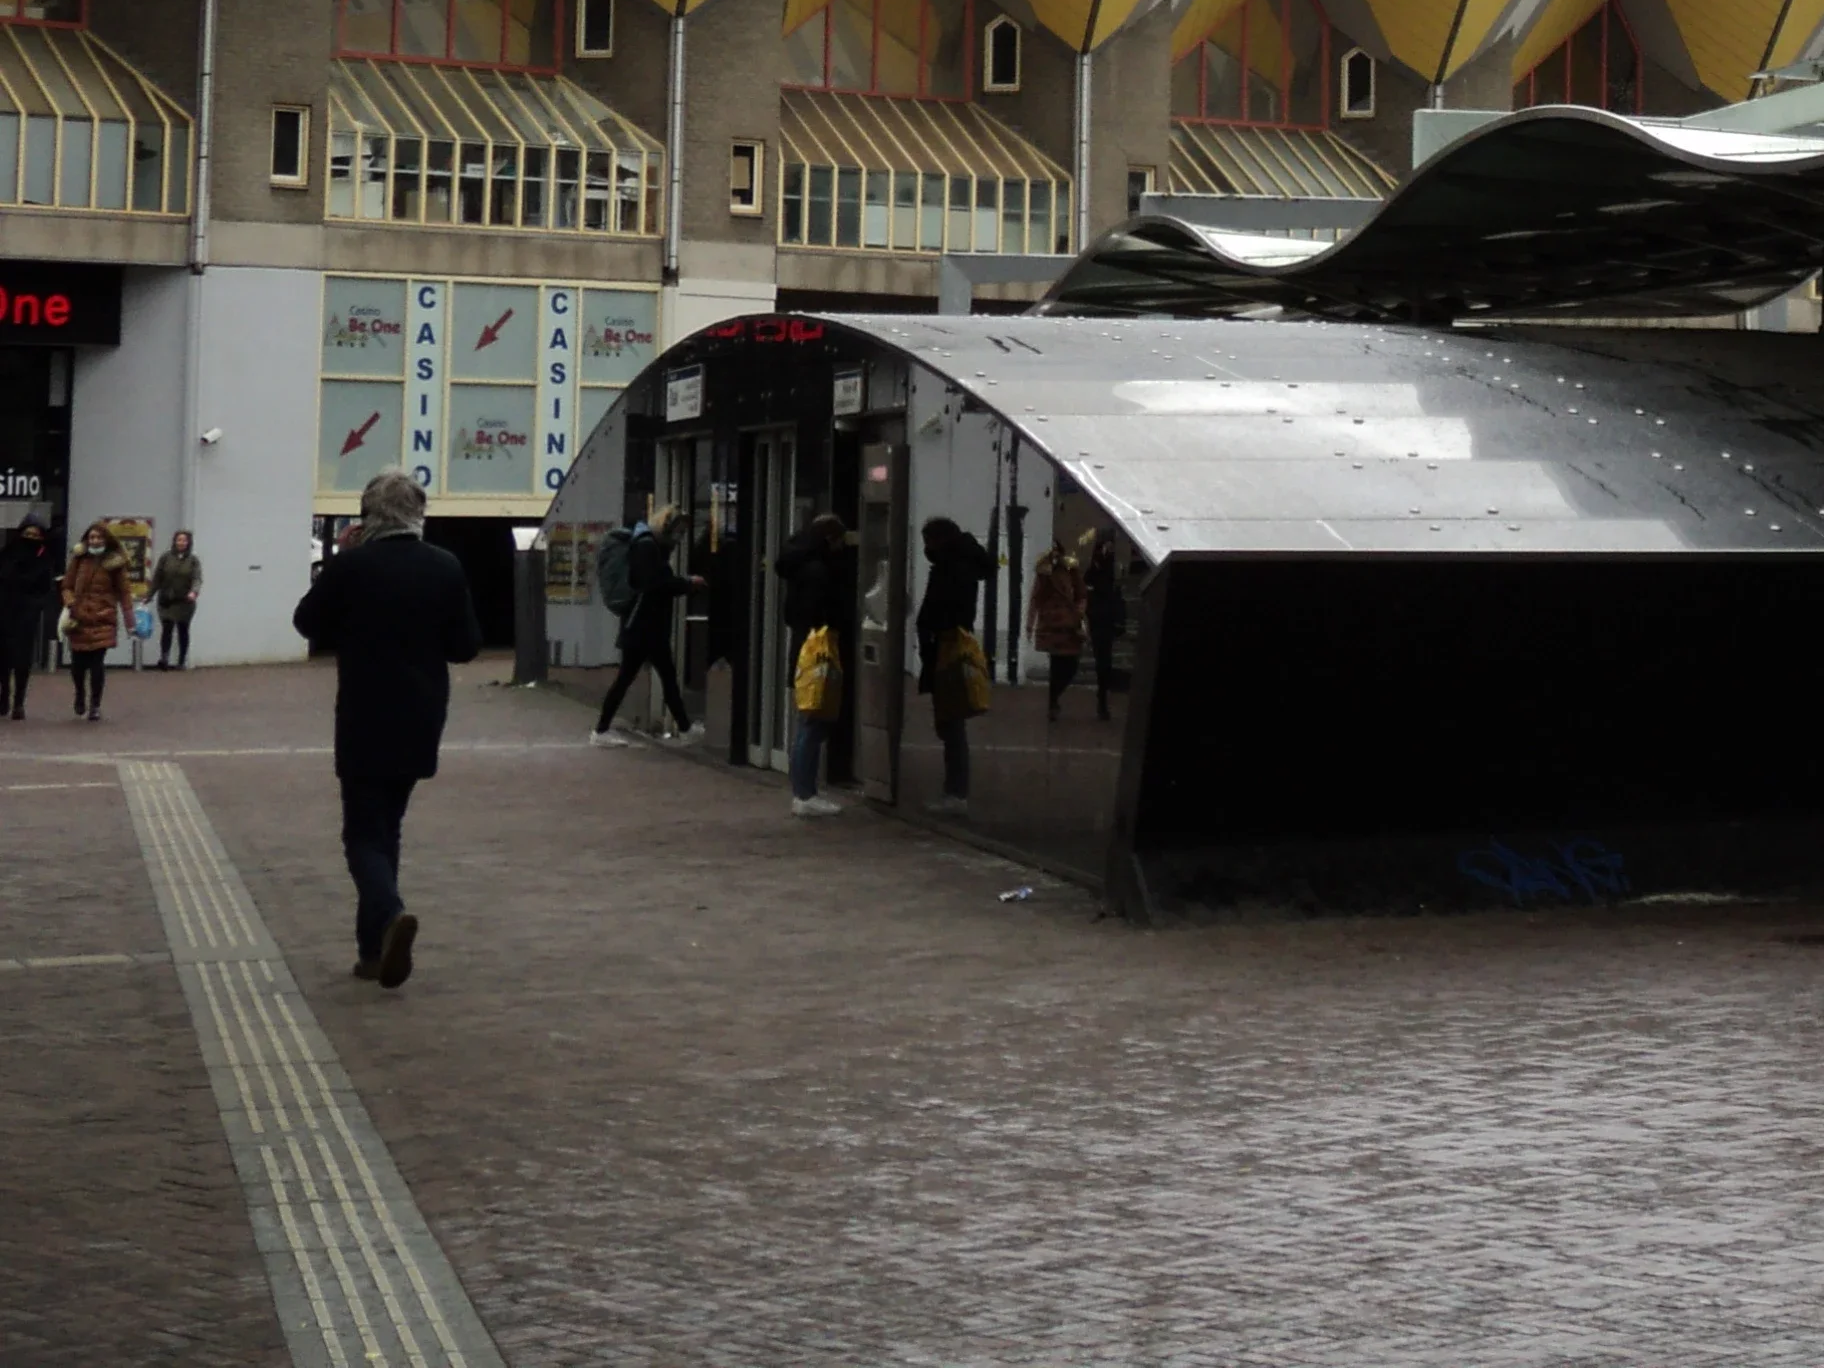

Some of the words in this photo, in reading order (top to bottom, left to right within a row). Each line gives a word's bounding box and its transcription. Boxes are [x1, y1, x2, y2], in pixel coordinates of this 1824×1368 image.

[0, 285, 71, 327] ne
[349, 305, 381, 316] Casino
[348, 318, 367, 333] Be
[371, 319, 401, 334] One
[604, 316, 635, 327] Casino
[603, 328, 620, 343] Be
[625, 329, 653, 344] One
[413, 286, 436, 487] CASINO
[546, 292, 568, 490] CASINO
[477, 417, 508, 428] Casino
[475, 430, 493, 445] Be
[497, 431, 527, 446] One
